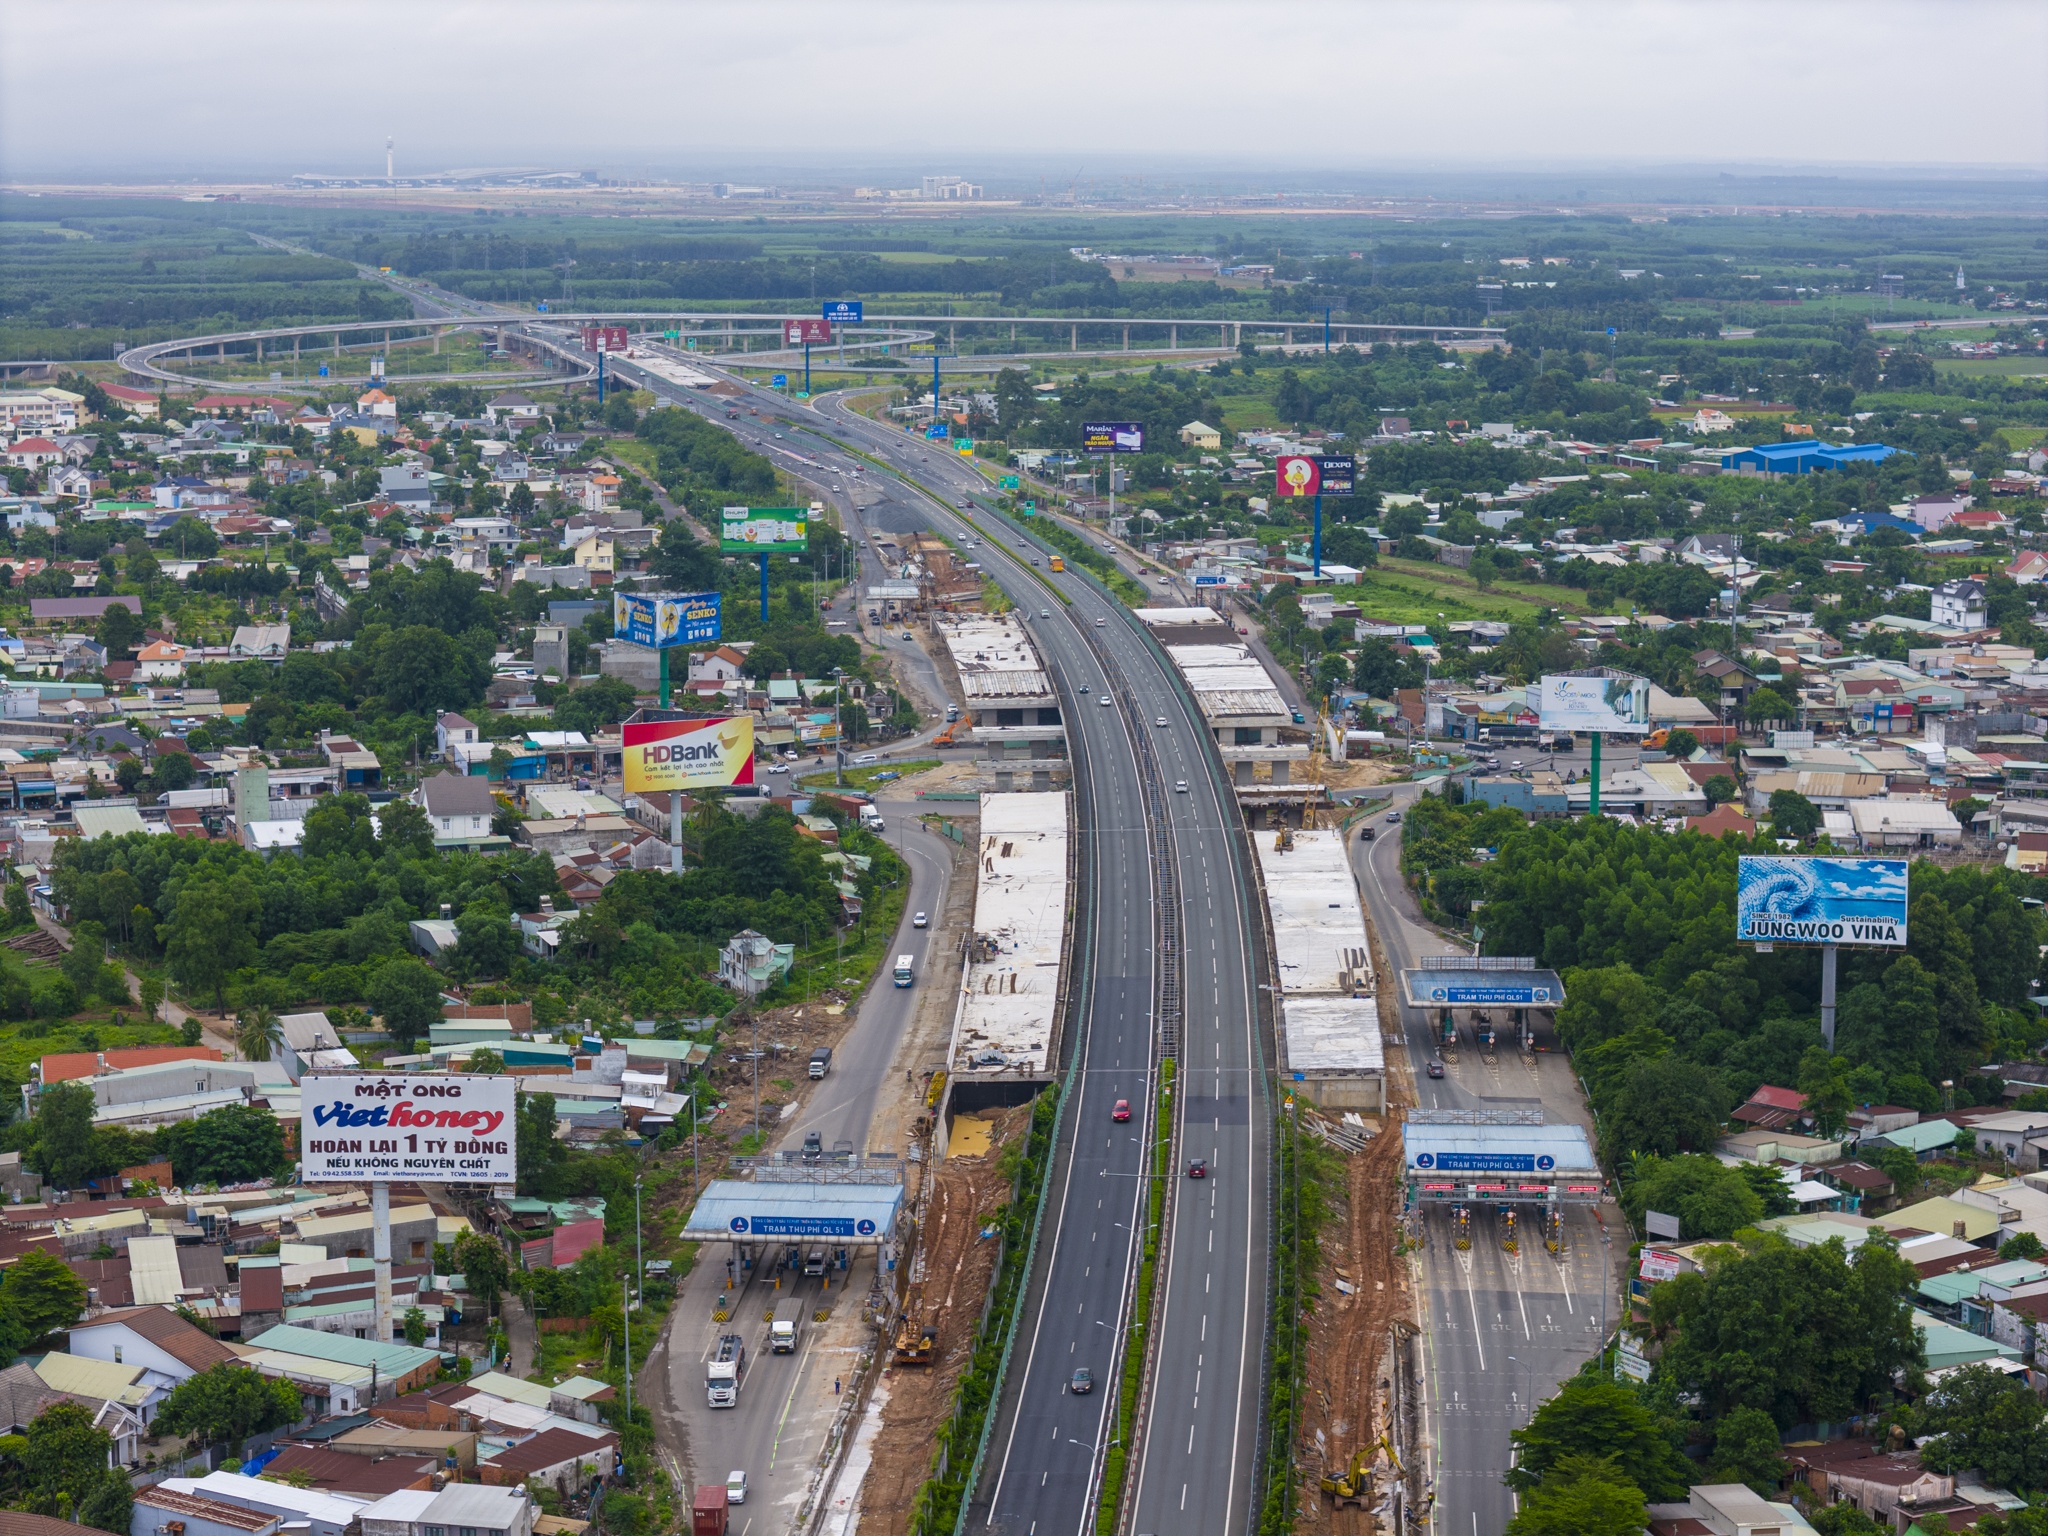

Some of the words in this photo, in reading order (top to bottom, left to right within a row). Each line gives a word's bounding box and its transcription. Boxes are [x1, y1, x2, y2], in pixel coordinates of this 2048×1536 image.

[634, 611, 652, 624] SENKO
[686, 608, 716, 620] SENKO
[644, 742, 718, 764] HDBank
[1840, 915, 1899, 925] Sustainability
[1746, 921, 1844, 939] JUNGWOO
[1851, 924, 1897, 940] VINA
[355, 1080, 406, 1099] MẬT
[413, 1085, 461, 1097] ONG
[312, 1101, 504, 1136] Viethoney
[310, 1138, 361, 1153] HOÀN
[369, 1140, 397, 1155] LẠI
[404, 1134, 418, 1153] 1
[424, 1137, 447, 1153] TỶ
[454, 1137, 508, 1154] ĐỒNG
[326, 1155, 350, 1168] NẾU
[355, 1156, 399, 1168] KHÔNG
[404, 1157, 454, 1168] NGUYÊN
[459, 1156, 490, 1169] CHẤT
[1490, 1160, 1502, 1168] PHÍ
[807, 1225, 820, 1233] PHÍ
